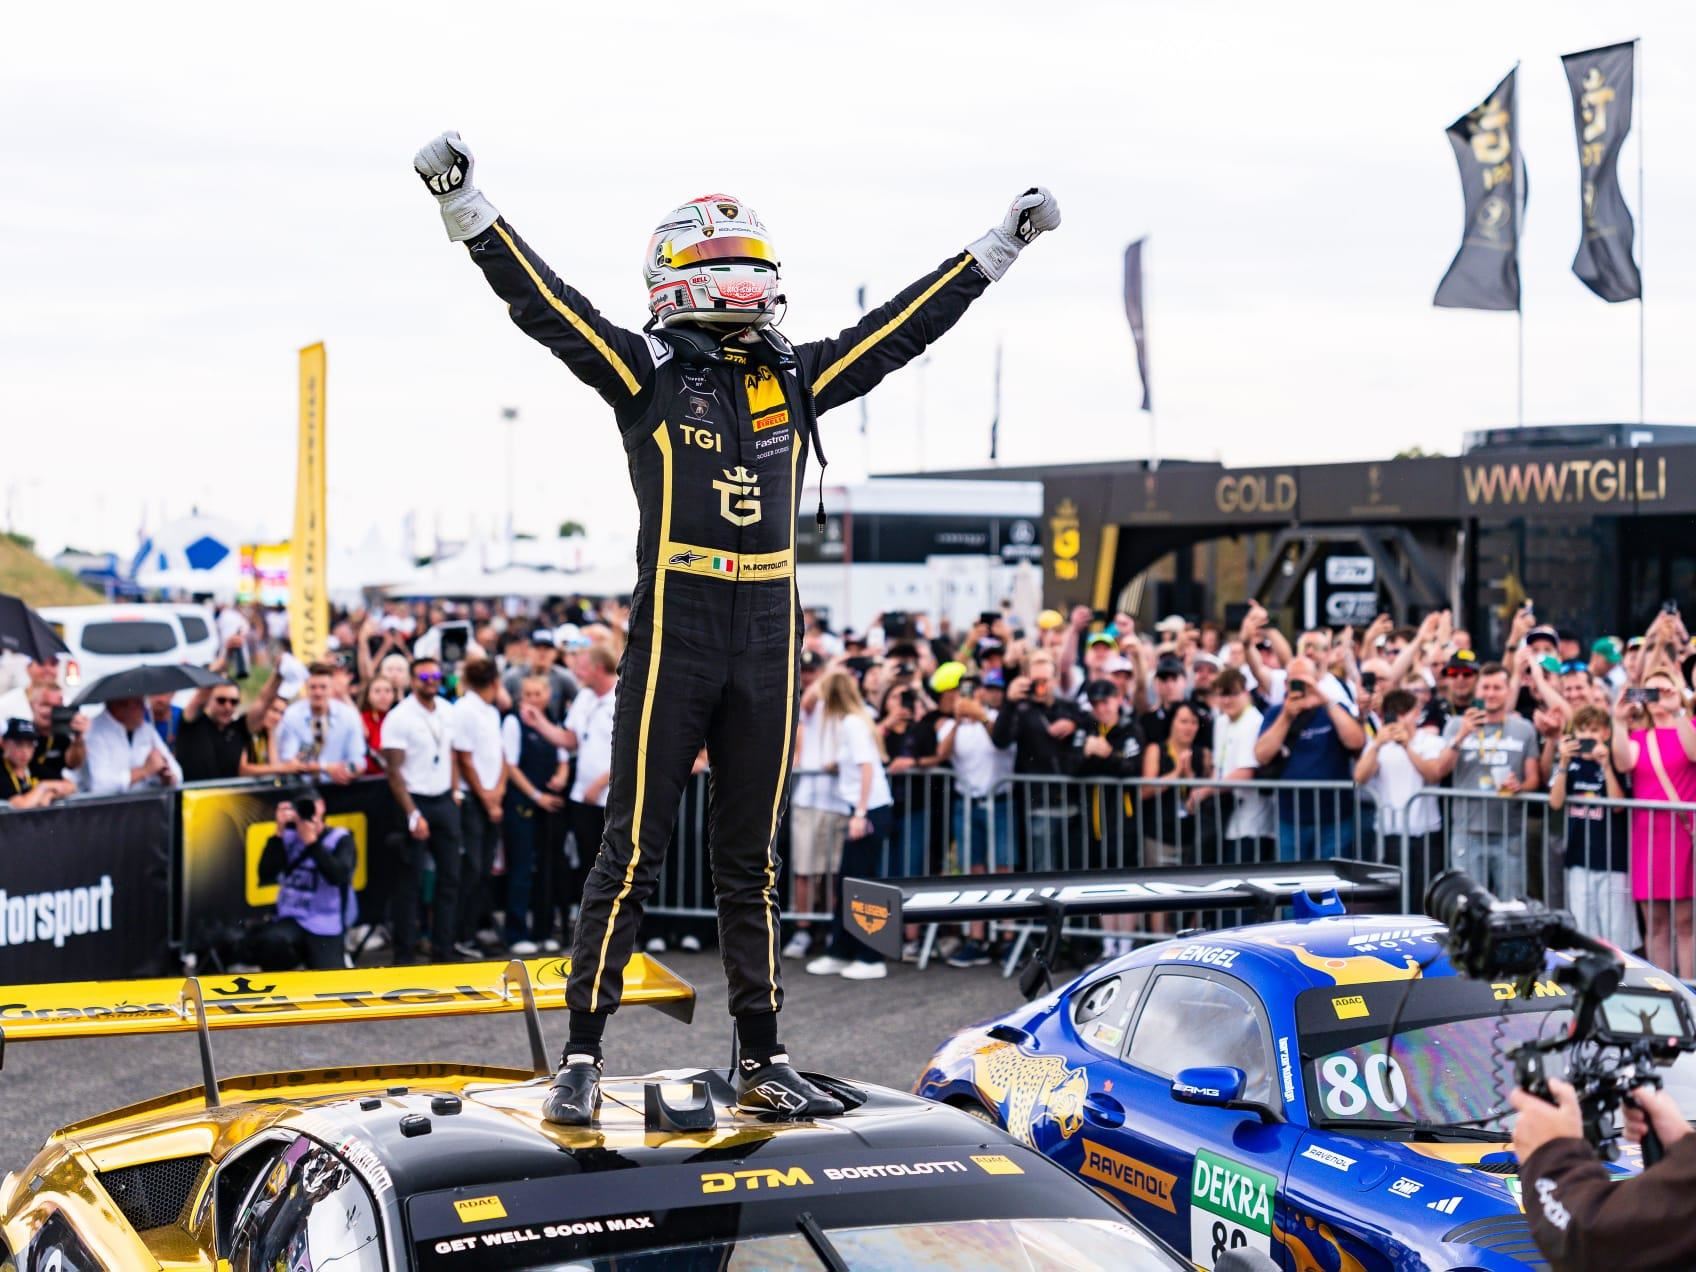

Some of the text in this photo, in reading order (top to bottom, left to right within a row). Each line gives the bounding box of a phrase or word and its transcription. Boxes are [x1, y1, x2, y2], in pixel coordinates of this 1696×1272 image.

[692, 276, 708, 284] BELL
[724, 354, 747, 365] DTM
[756, 413, 786, 430] PIRELLI
[680, 424, 722, 453] TGI
[755, 434, 789, 449] Fastron
[1216, 474, 1297, 512] GOLD
[753, 560, 788, 571] BORTOLOTTI
[1178, 945, 1241, 969] ENGEL
[1490, 980, 1567, 1001] DM
[1335, 997, 1363, 1007] ADAC
[1322, 1053, 1408, 1116] 80
[1309, 1148, 1348, 1168] RAVENOL
[701, 1166, 815, 1194] DTM
[823, 1160, 969, 1181] BORTOLOTTI
[1090, 1151, 1168, 1200] RAVENOL
[1193, 1159, 1270, 1225] DEKRA
[1391, 1180, 1421, 1195] OMP
[458, 1198, 498, 1209] ADAC
[435, 1216, 655, 1255] GET WELL SOON MAX
